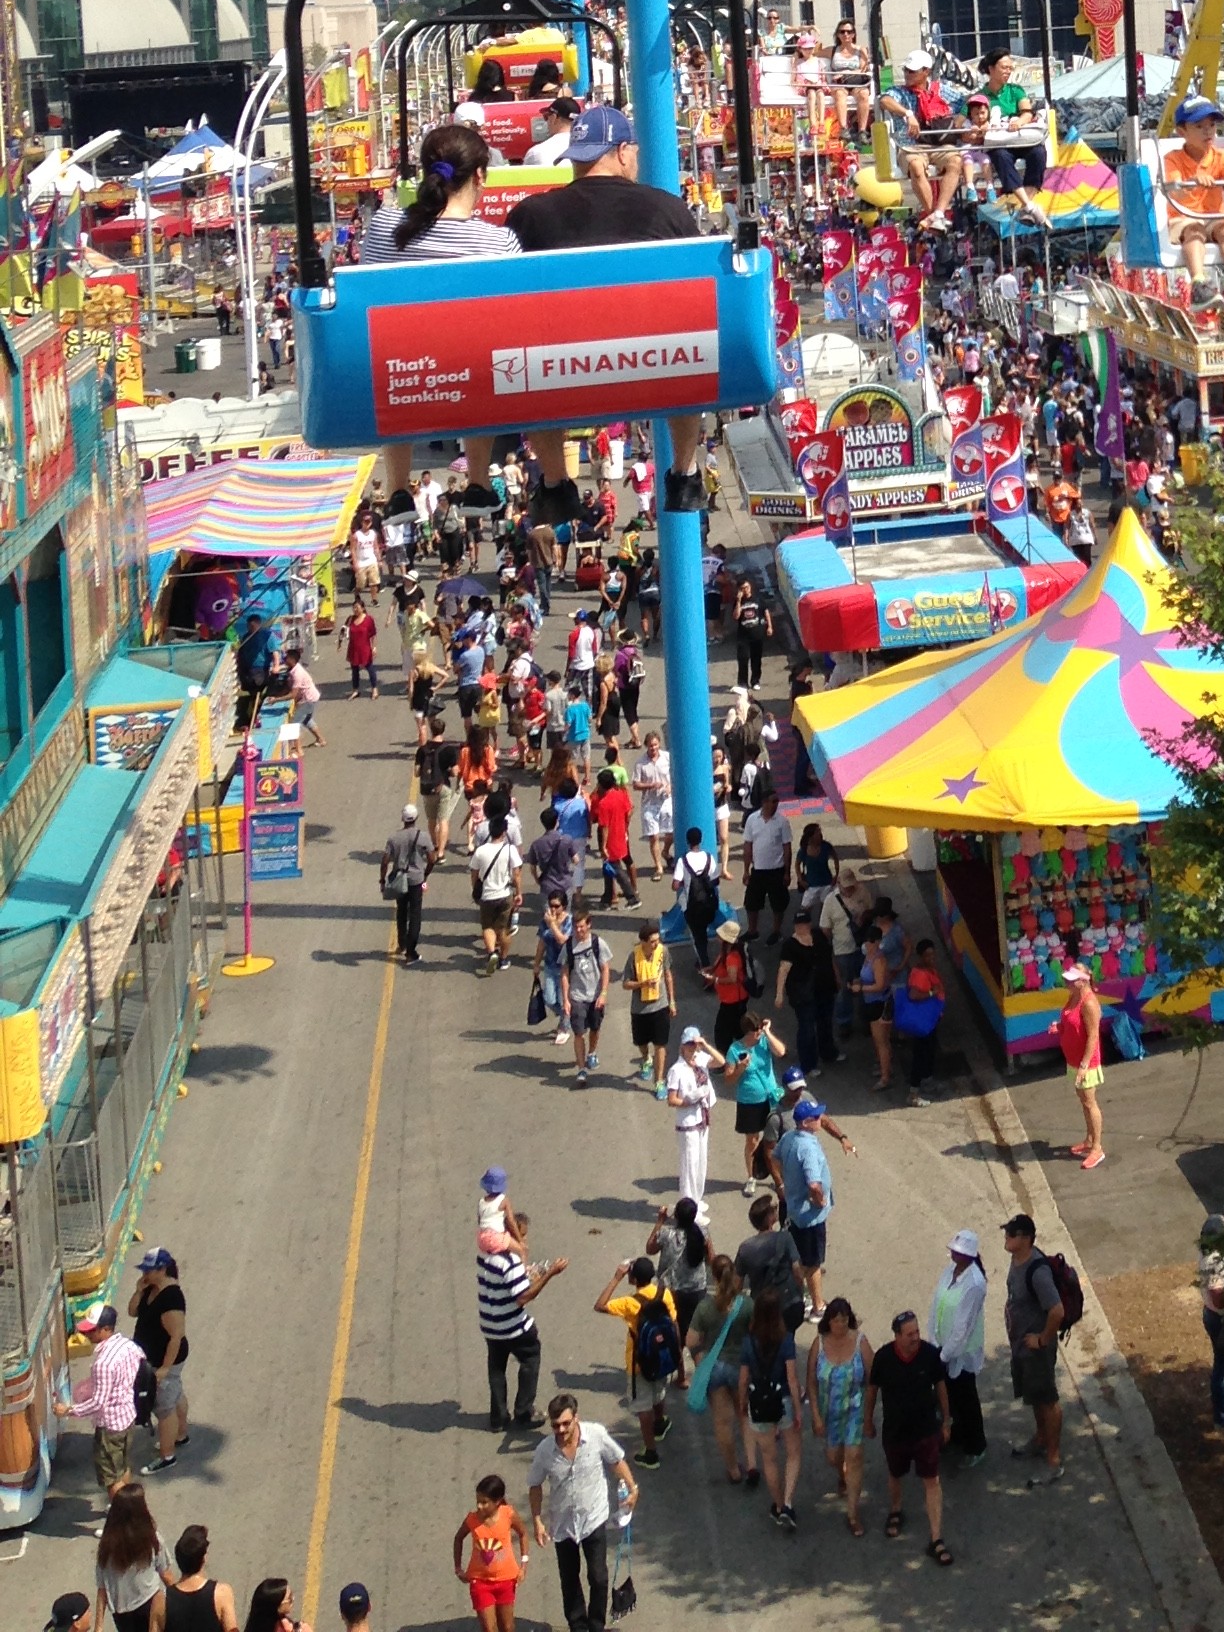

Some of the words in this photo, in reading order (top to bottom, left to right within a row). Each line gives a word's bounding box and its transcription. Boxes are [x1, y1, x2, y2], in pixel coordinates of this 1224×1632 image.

[483, 194, 498, 203] no
[485, 206, 504, 216] fee
[542, 346, 705, 378] FINANCIAL
[387, 374, 420, 391] just
[425, 368, 470, 388] good
[388, 389, 467, 405] banking.
[840, 422, 909, 448] ARAMEL
[139, 445, 260, 482] OFFEE
[875, 488, 926, 508] APPLES
[755, 505, 803, 515] DRINKS
[262, 779, 272, 793] 4
